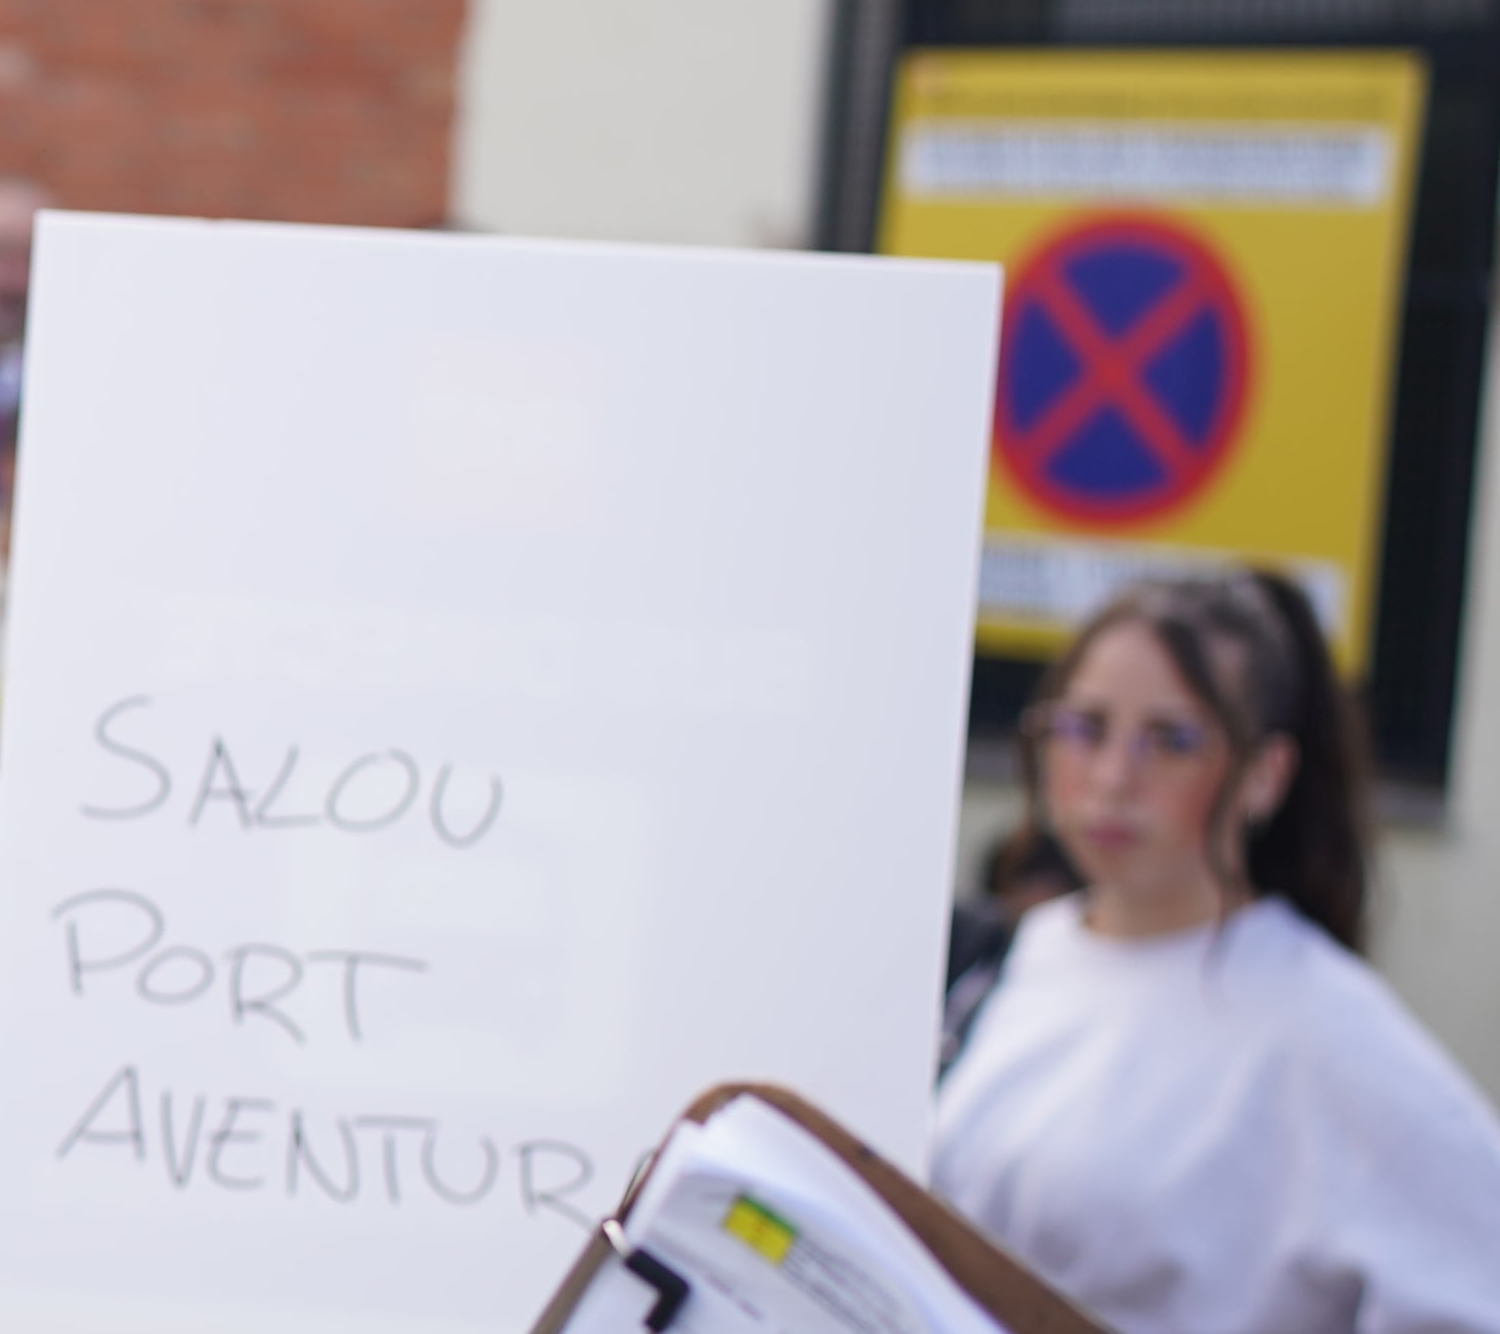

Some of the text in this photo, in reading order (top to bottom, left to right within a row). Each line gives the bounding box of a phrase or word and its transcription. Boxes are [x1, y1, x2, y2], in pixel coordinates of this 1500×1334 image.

[78, 693, 505, 850] SALOU
[48, 887, 430, 1045] PORT
[56, 1063, 600, 1233] AVENTUR
